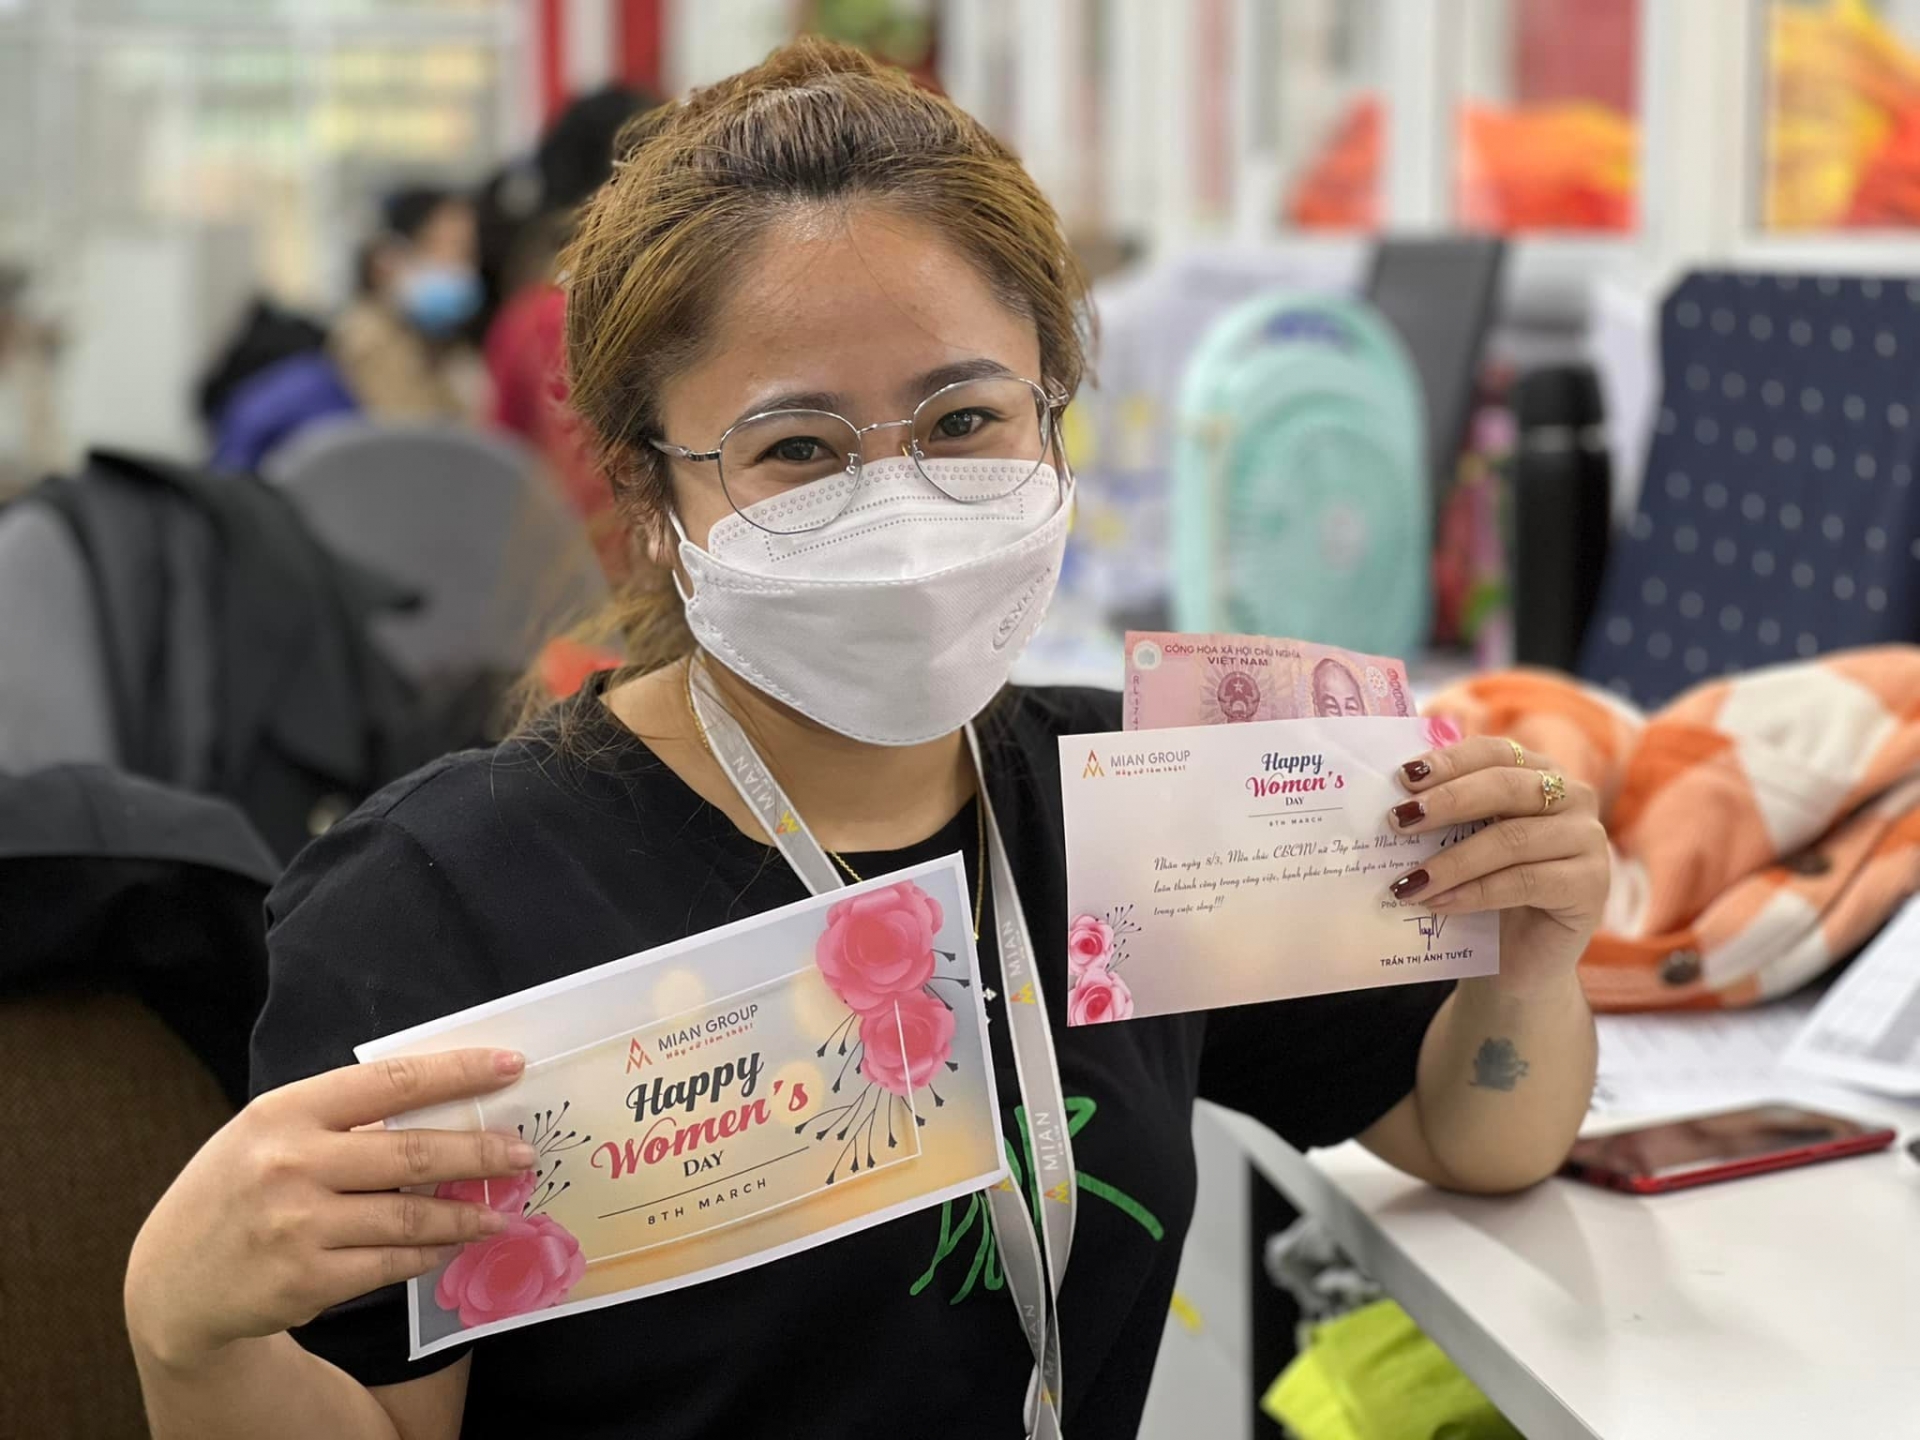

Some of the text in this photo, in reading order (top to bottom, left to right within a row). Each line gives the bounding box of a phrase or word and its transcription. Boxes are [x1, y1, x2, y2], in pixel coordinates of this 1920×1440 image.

[1240, 658, 1268, 666] NAM
[1110, 750, 1191, 768] MIAN GROUP
[1261, 752, 1324, 775] Happy
[733, 756, 775, 811] MIAN
[1245, 771, 1344, 798] Women's
[1285, 796, 1304, 806] DAY
[1291, 817, 1323, 825] MARCH
[1002, 921, 1022, 978] MIAN
[1407, 955, 1421, 964] THỊ
[658, 1004, 758, 1052] MIAN GROUP
[626, 1052, 764, 1122] Happy
[590, 1080, 809, 1179] Women's
[1035, 1112, 1059, 1171] MIAN
[683, 1150, 724, 1177] DAY
[648, 1178, 767, 1225] 8TH MARCH
